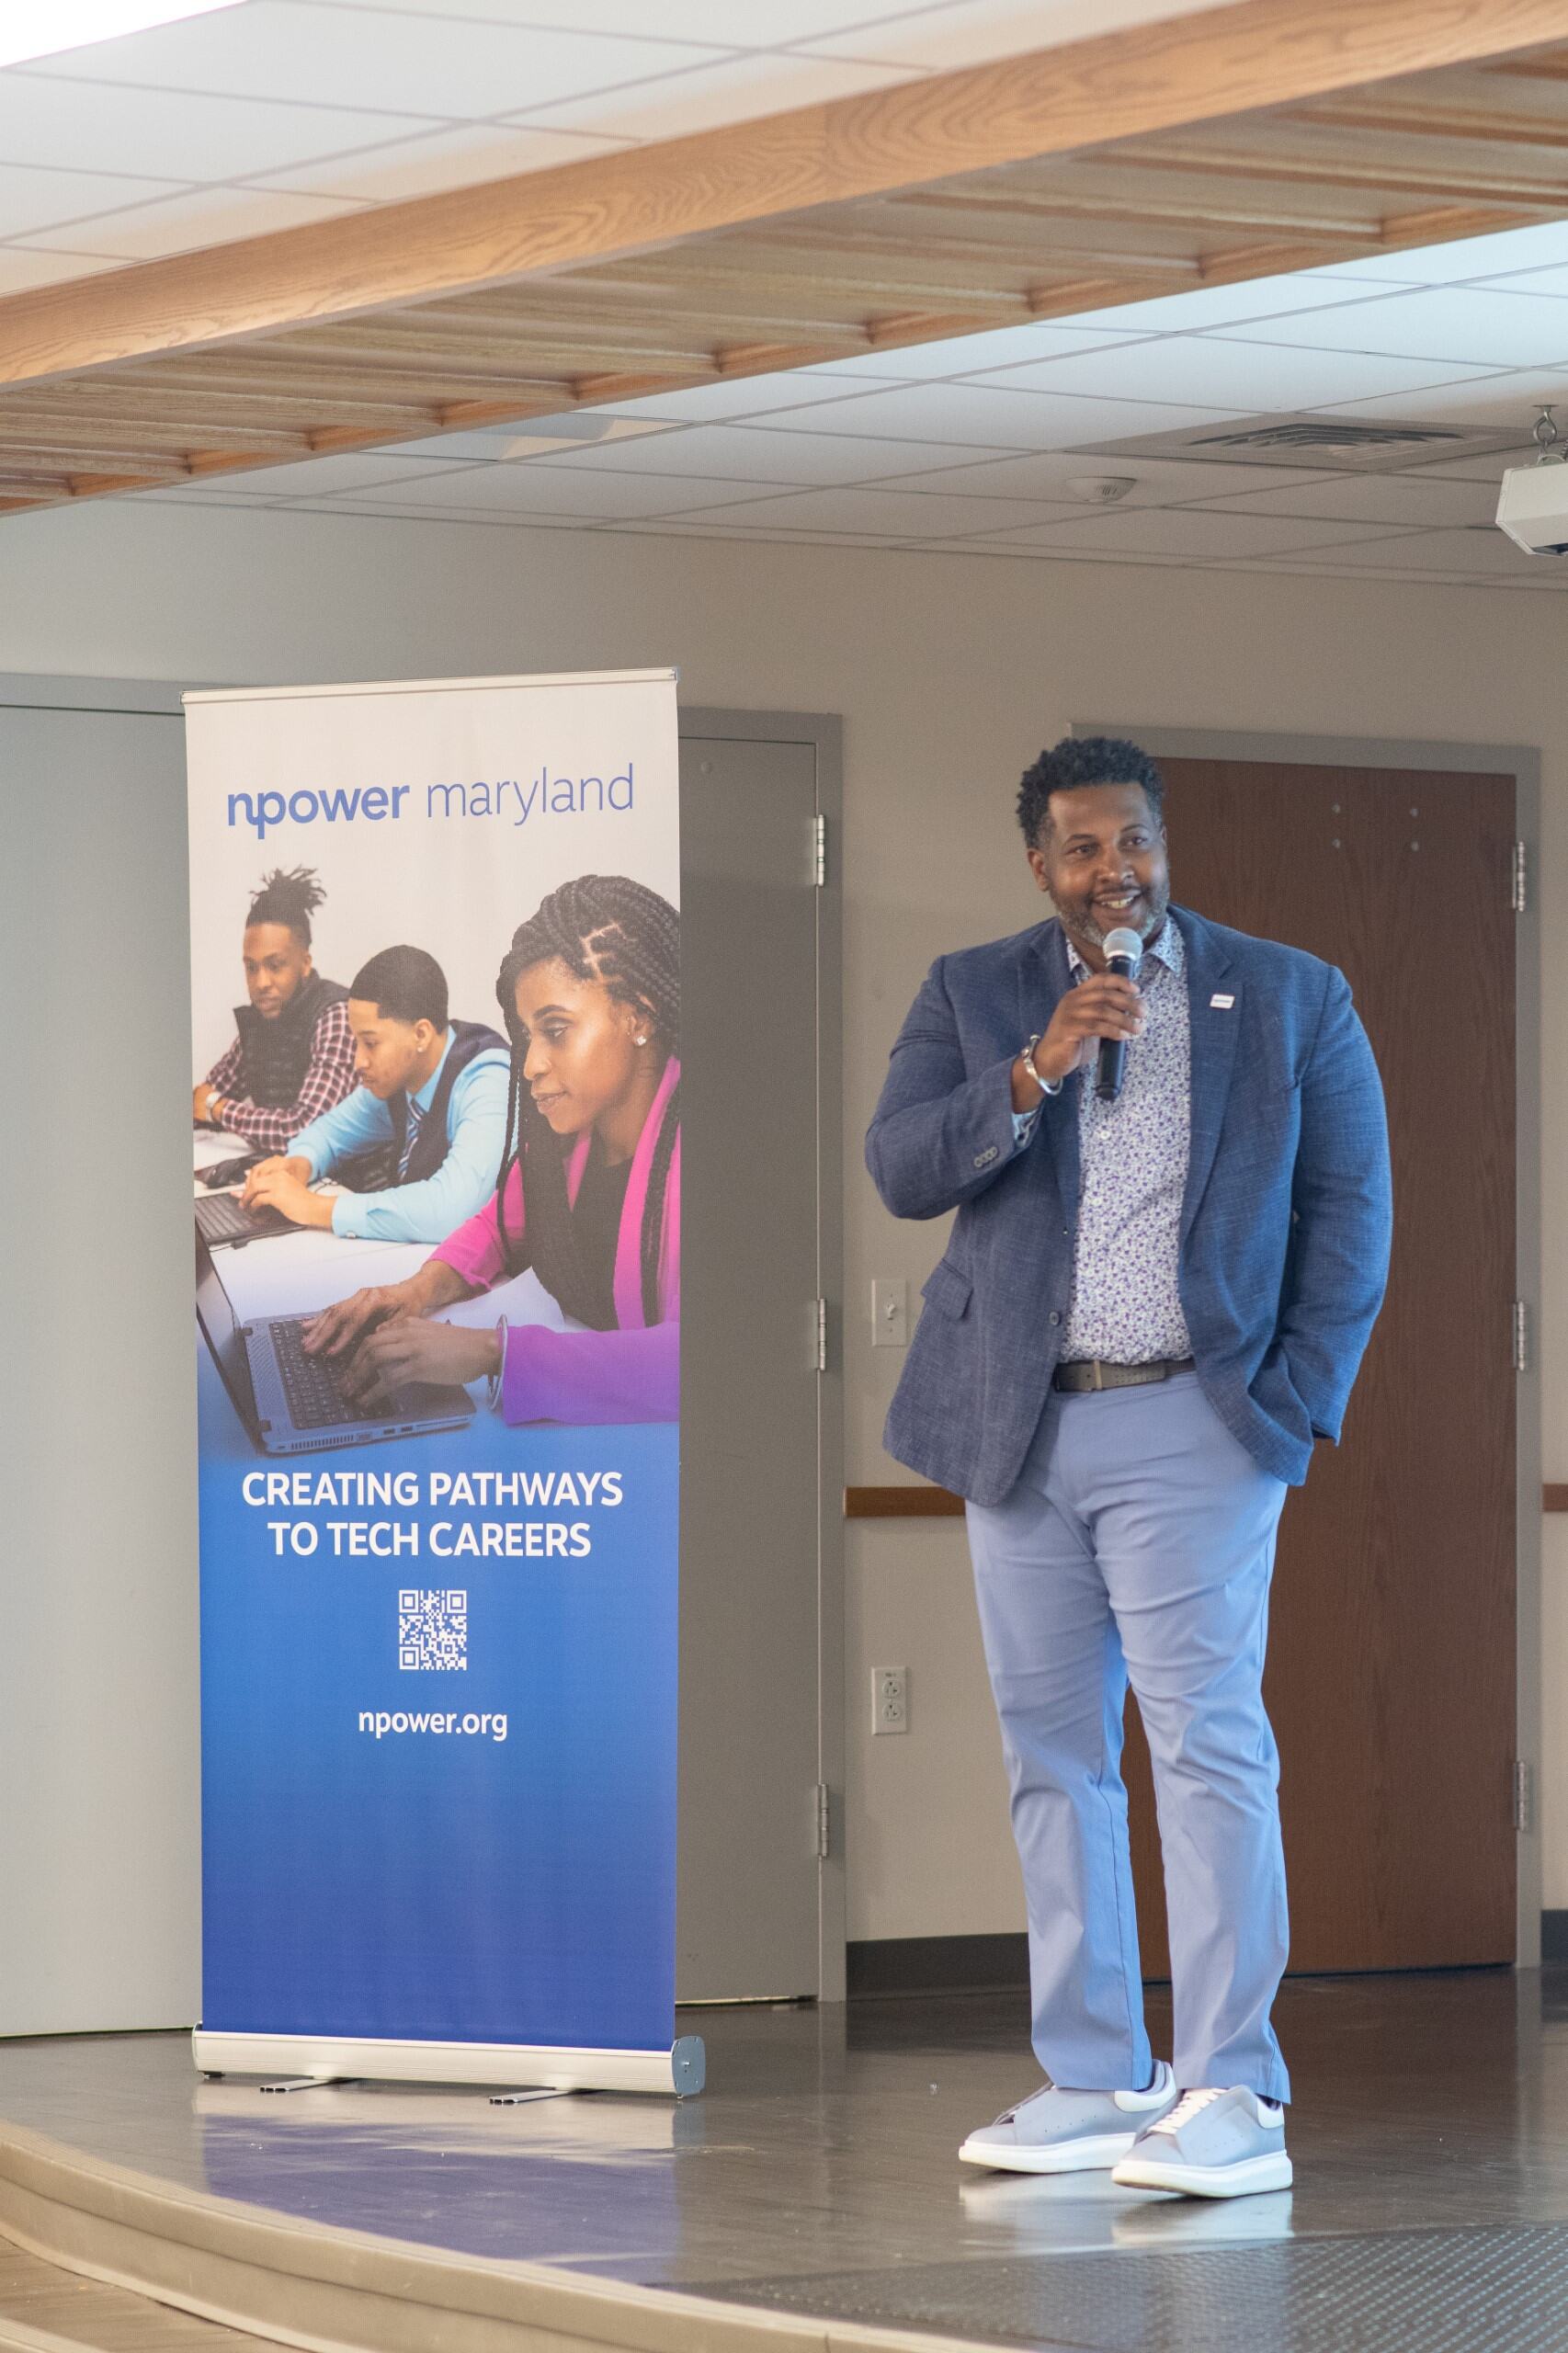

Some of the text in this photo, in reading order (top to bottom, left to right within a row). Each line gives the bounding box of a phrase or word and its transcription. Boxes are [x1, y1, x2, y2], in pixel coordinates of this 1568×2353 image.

[227, 763, 634, 840] npower maryland
[242, 1471, 623, 1507] CREATING PATHWAYS
[267, 1521, 592, 1558] TO TECH CAREERS
[358, 1711, 508, 1743] npower.org
